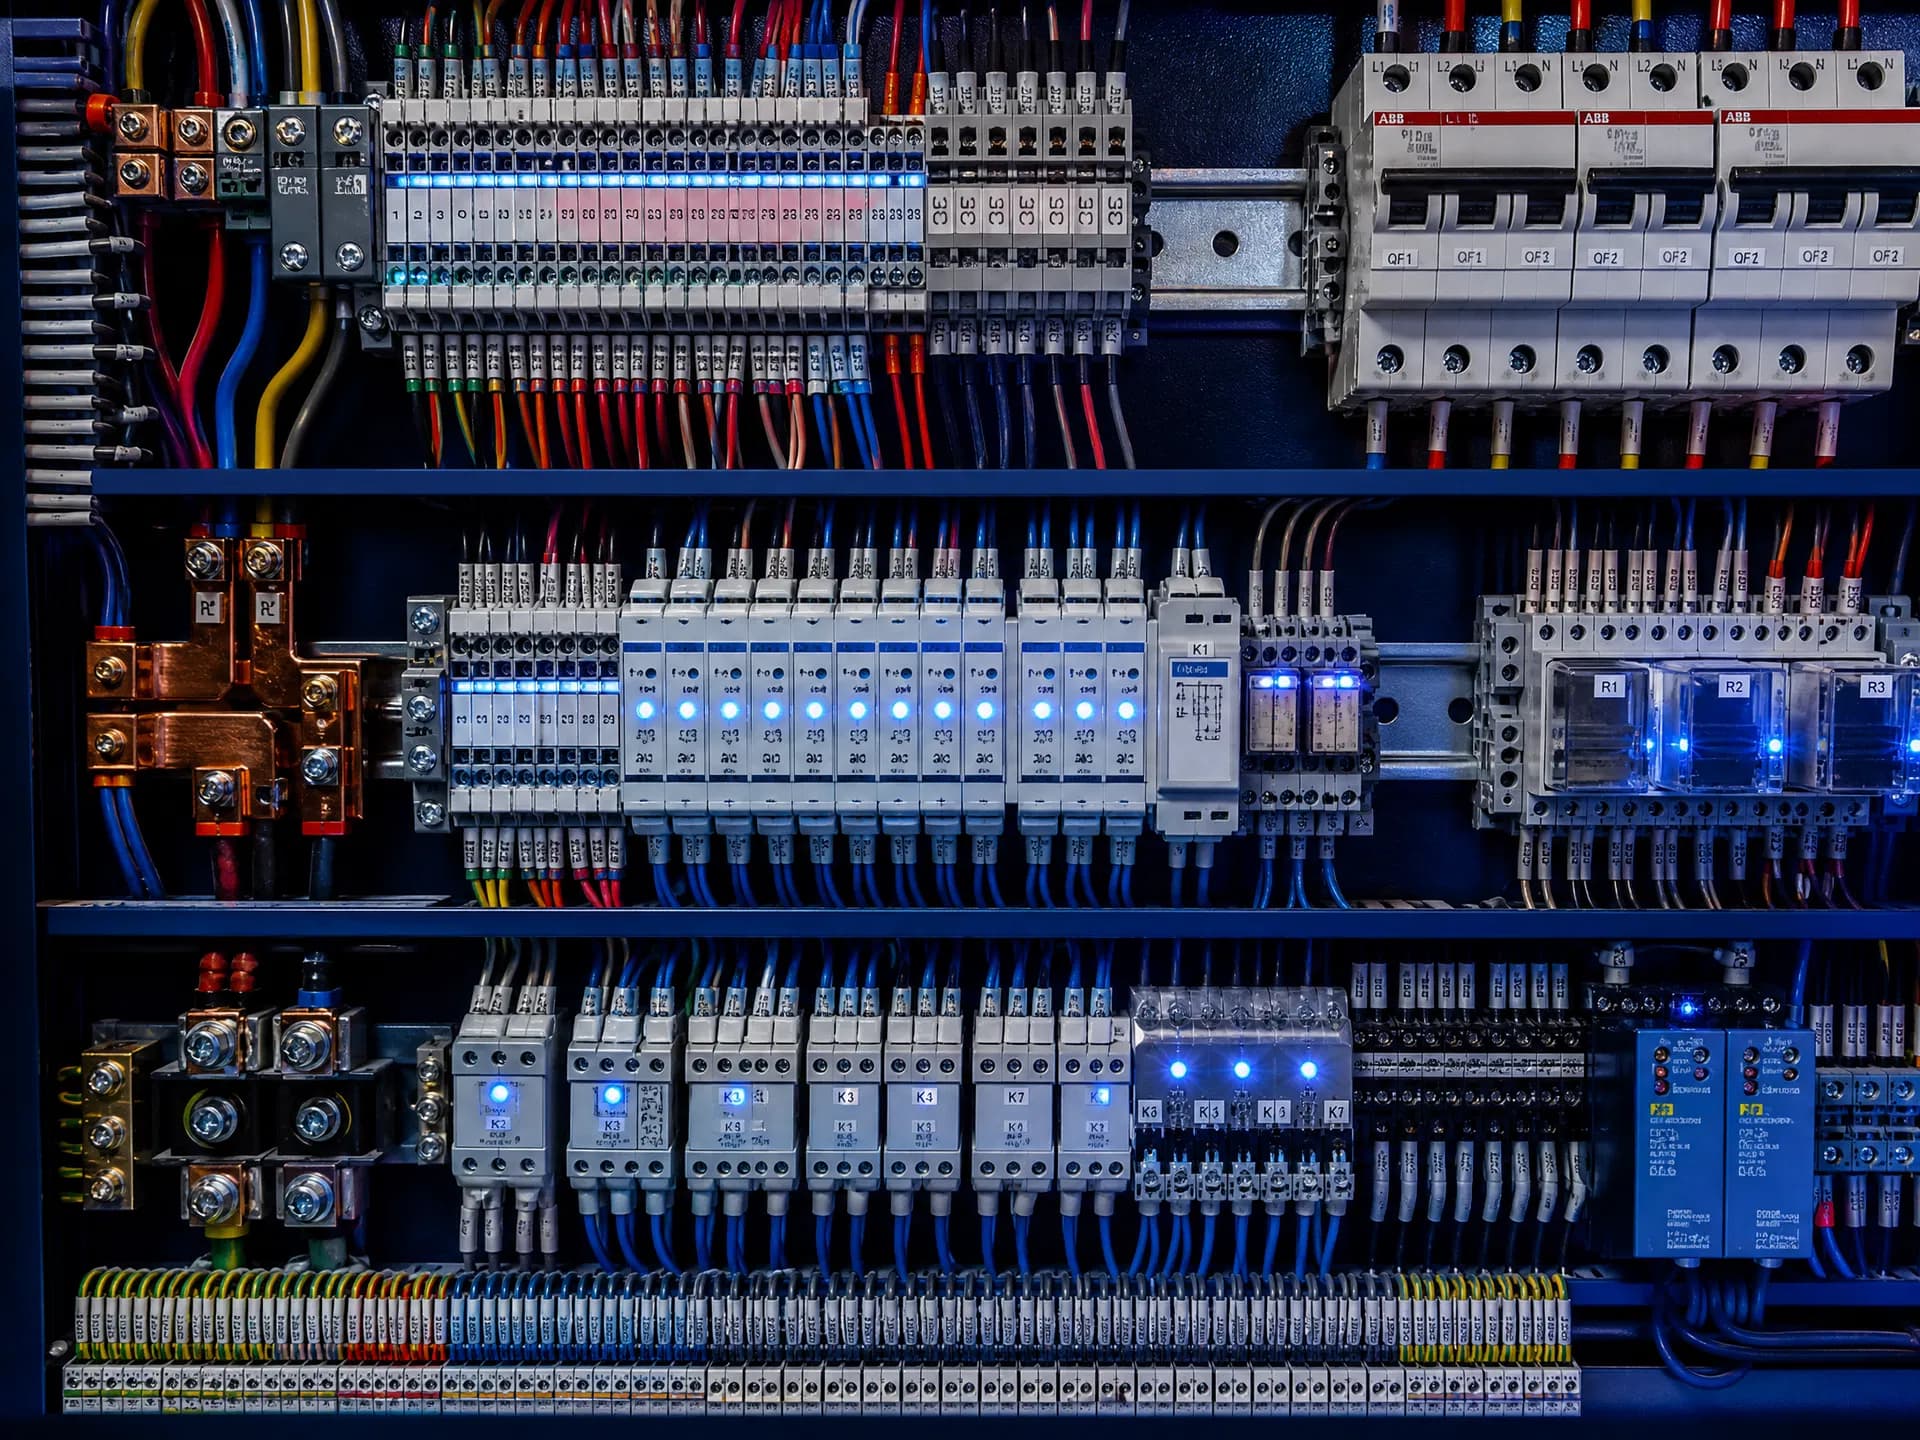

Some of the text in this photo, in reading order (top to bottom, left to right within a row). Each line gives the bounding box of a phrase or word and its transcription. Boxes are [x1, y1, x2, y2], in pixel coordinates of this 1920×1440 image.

[1542, 60, 1551, 71] N
[1609, 59, 1619, 71] N
[1677, 59, 1686, 71] N
[1749, 59, 1758, 71] N
[1885, 58, 1894, 69] N
[1378, 113, 1405, 124] ABB
[1583, 112, 1610, 124] ABB
[1725, 111, 1751, 123] ABB
[436, 210, 445, 220] 3
[1387, 253, 1412, 265] QF1
[1457, 251, 1482, 264] QF1
[1593, 252, 1618, 265] QF2
[1193, 644, 1208, 656] K1
[1601, 680, 1617, 693] R1
[1726, 680, 1743, 693] R2
[1867, 680, 1885, 693] R3
[838, 1092, 855, 1103] K3
[1008, 1091, 1025, 1103] K7
[1329, 1106, 1344, 1118] K7
[491, 1119, 506, 1129] K2
[605, 1120, 621, 1131] K3
